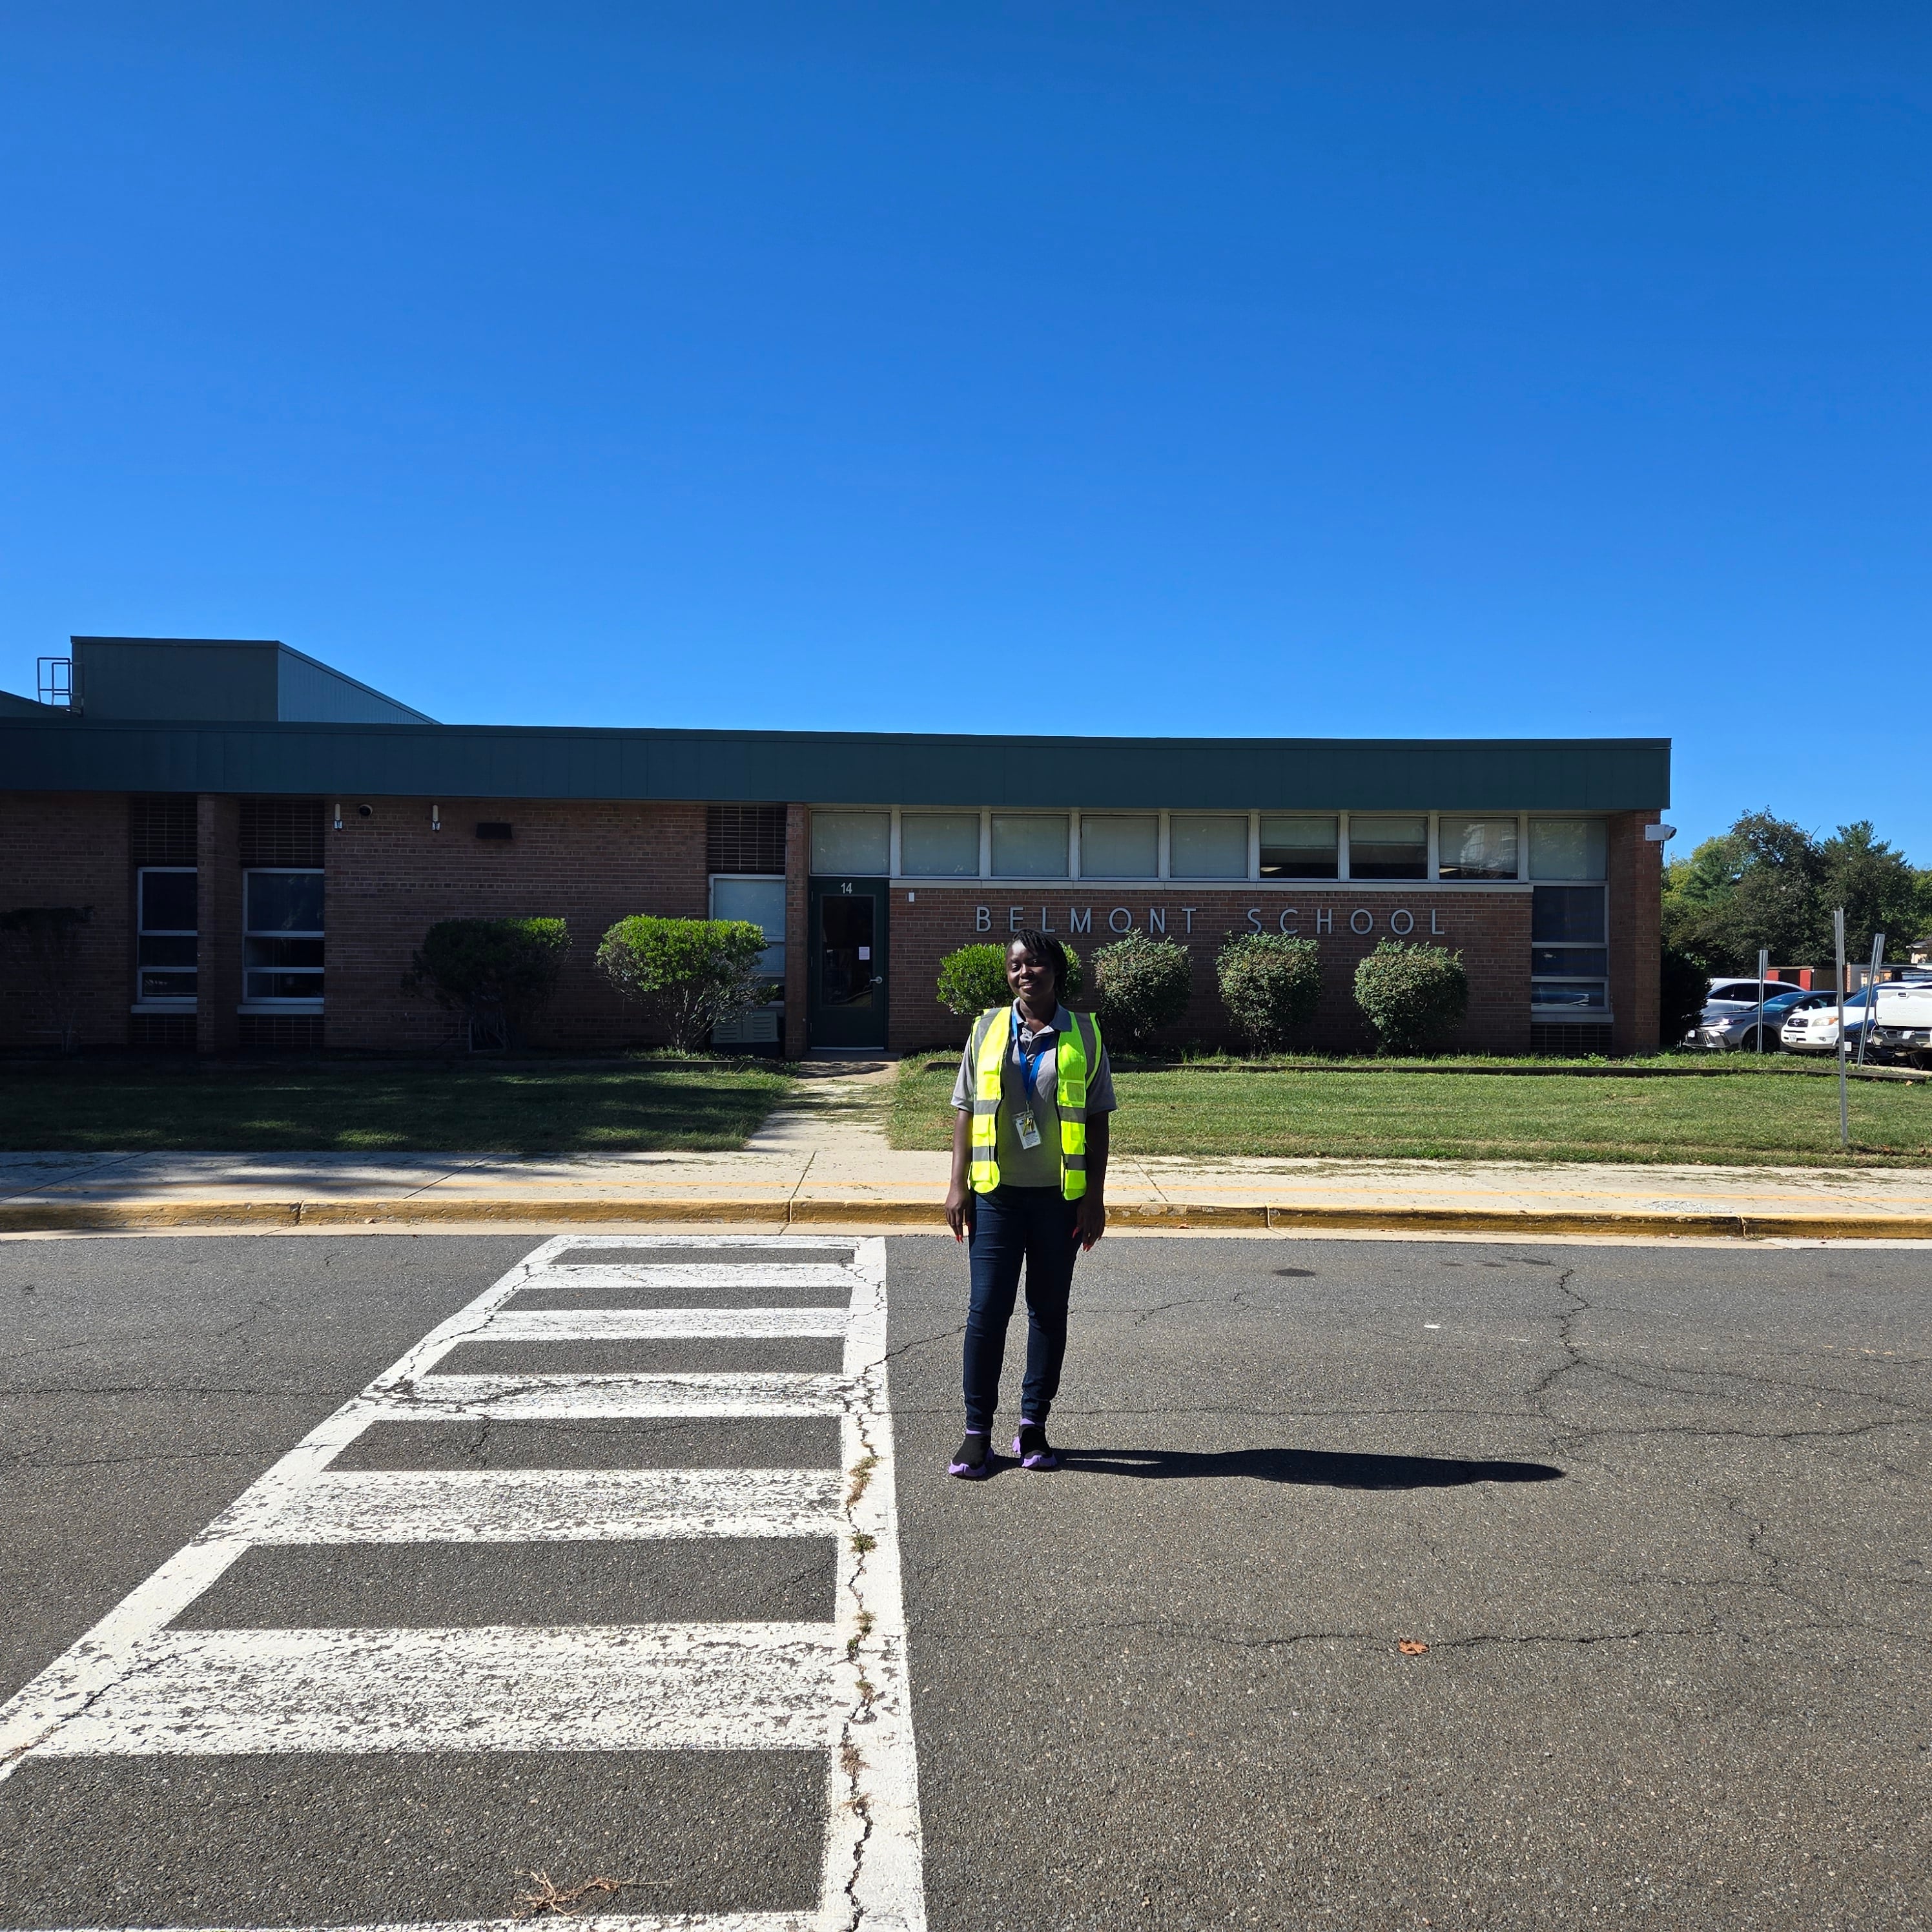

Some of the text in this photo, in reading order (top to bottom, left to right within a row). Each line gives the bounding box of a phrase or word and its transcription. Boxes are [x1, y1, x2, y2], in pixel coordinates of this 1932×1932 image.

[841, 882, 852, 894] 14
[976, 907, 1445, 934] BELMONT SCHOOL
